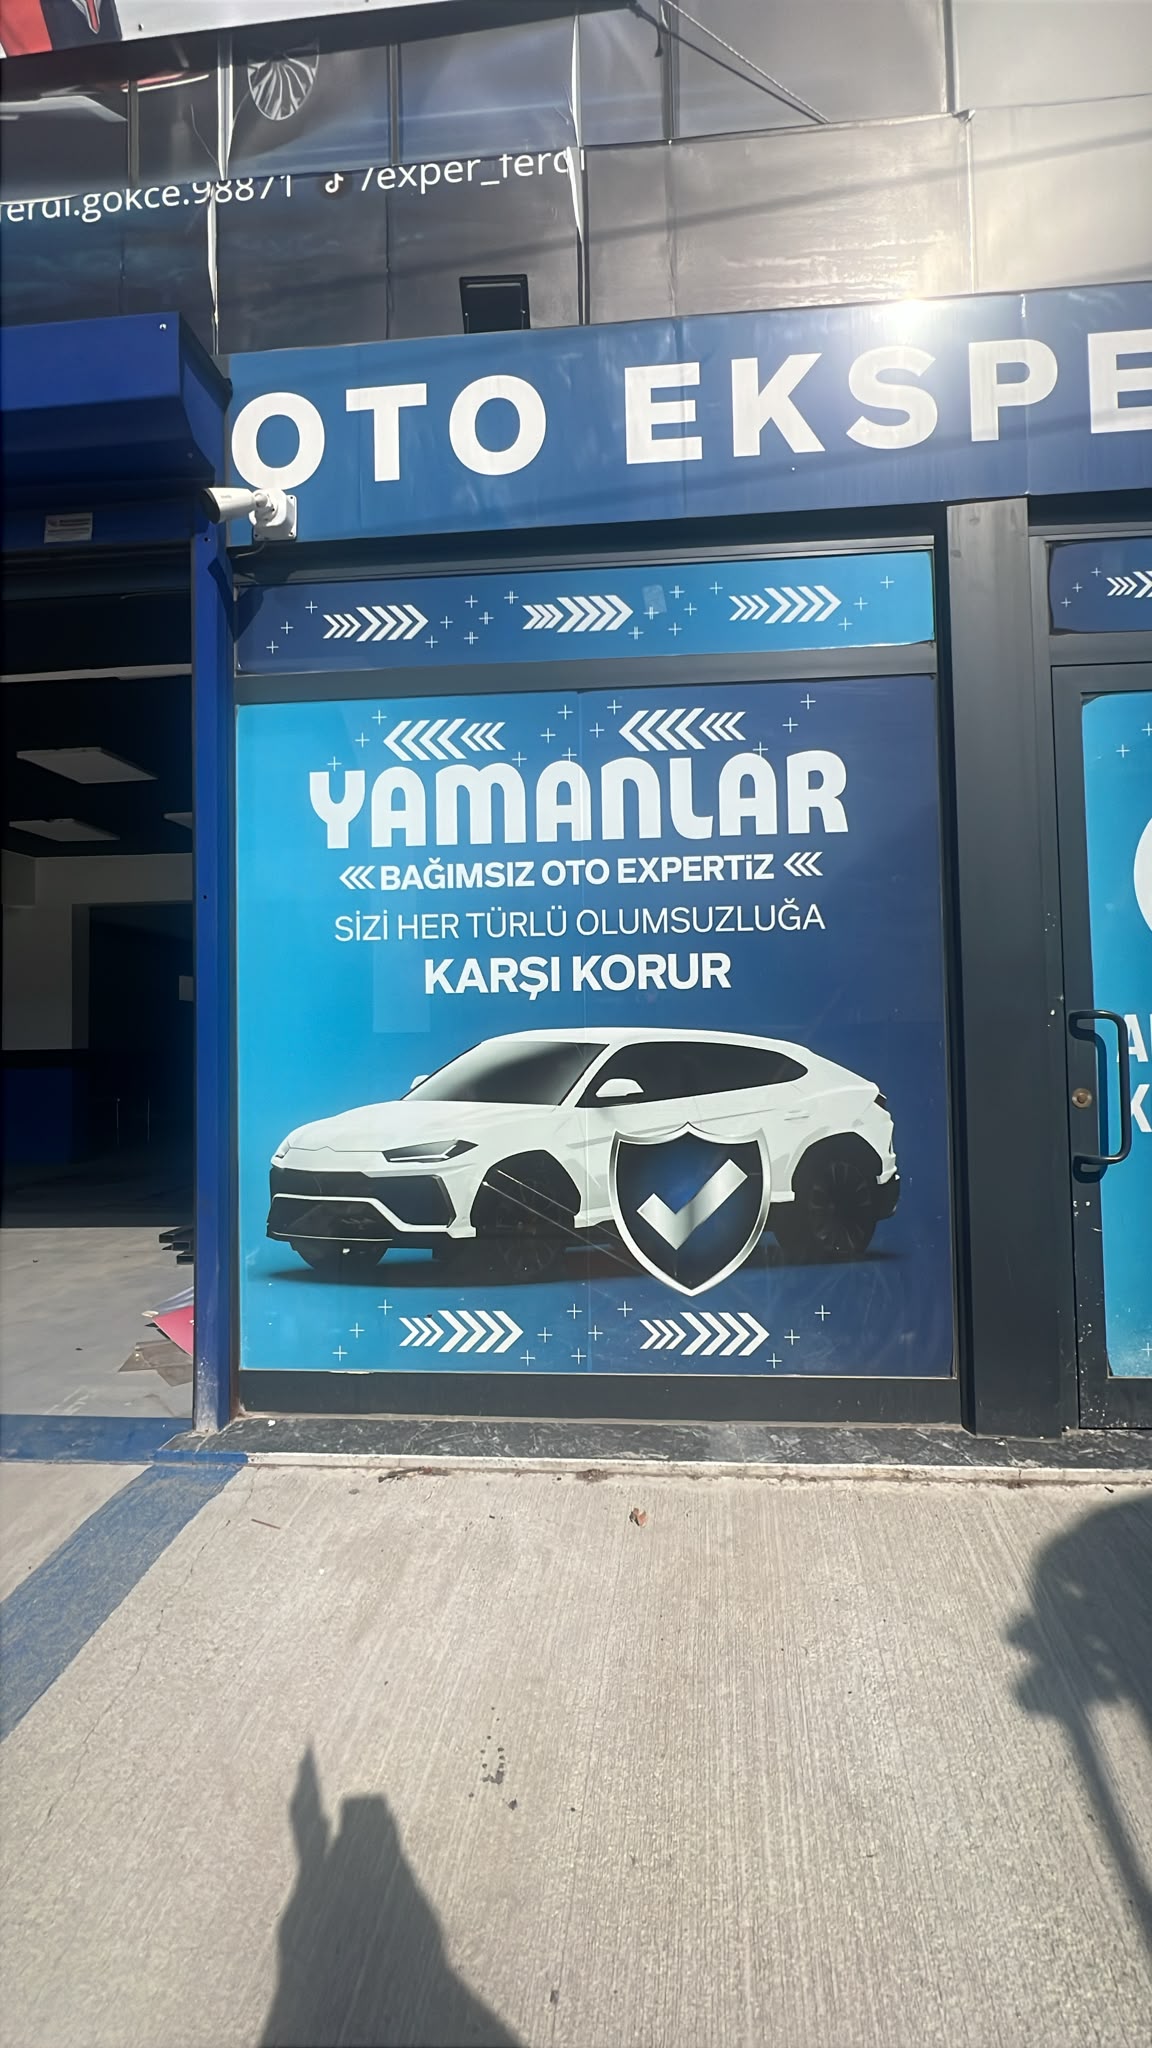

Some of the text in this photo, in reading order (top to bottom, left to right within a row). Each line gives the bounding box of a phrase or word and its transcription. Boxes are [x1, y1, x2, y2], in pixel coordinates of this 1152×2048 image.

[231, 329, 1152, 491] OTO EKSPE
[309, 750, 849, 849] YAMANLAR
[380, 857, 535, 891] BAĞIMSIZ
[541, 858, 610, 887] OTO
[334, 897, 826, 942] SİZİ HER TÜRLÜ OLUMSUZLUĞA
[425, 952, 732, 1001] KARŞI KORUR
